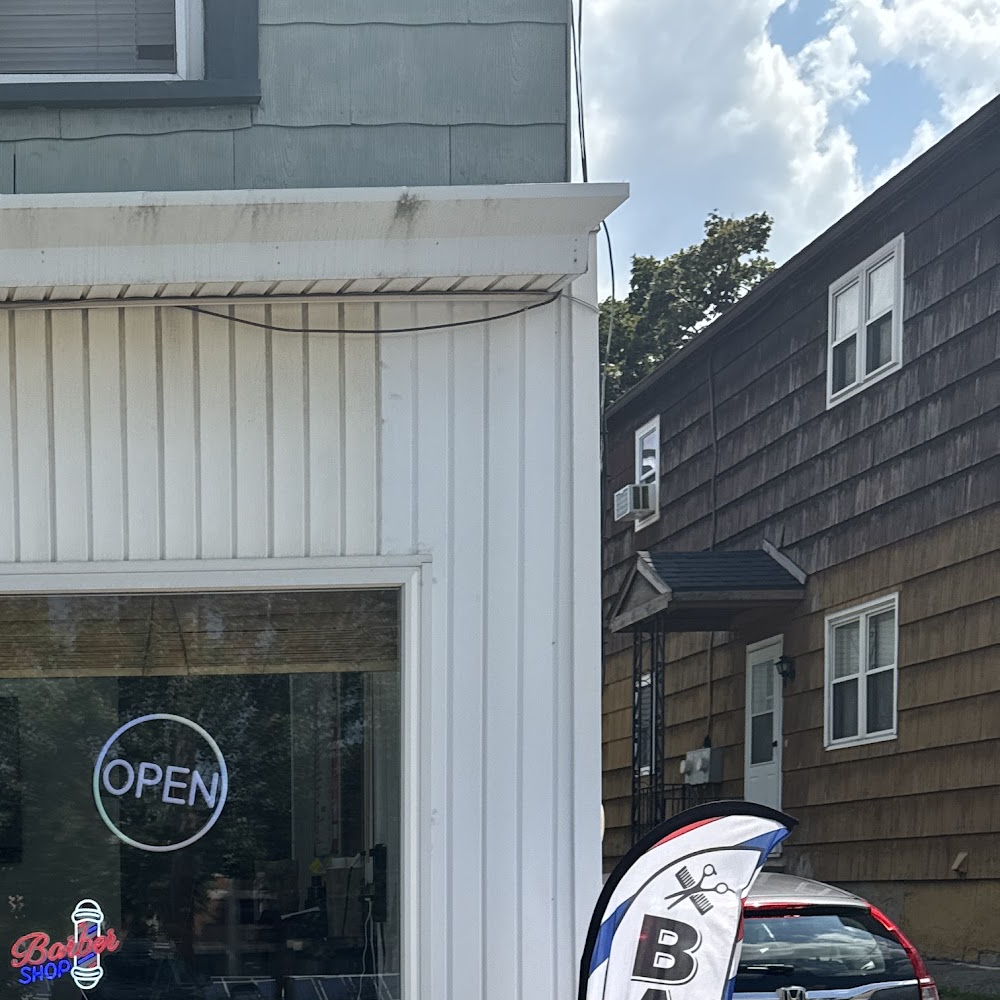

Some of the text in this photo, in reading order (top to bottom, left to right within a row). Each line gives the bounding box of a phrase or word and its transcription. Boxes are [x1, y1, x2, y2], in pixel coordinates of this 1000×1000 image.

[102, 758, 219, 808] OPEN
[10, 923, 120, 968] Barber
[18, 959, 71, 985] SHOP
